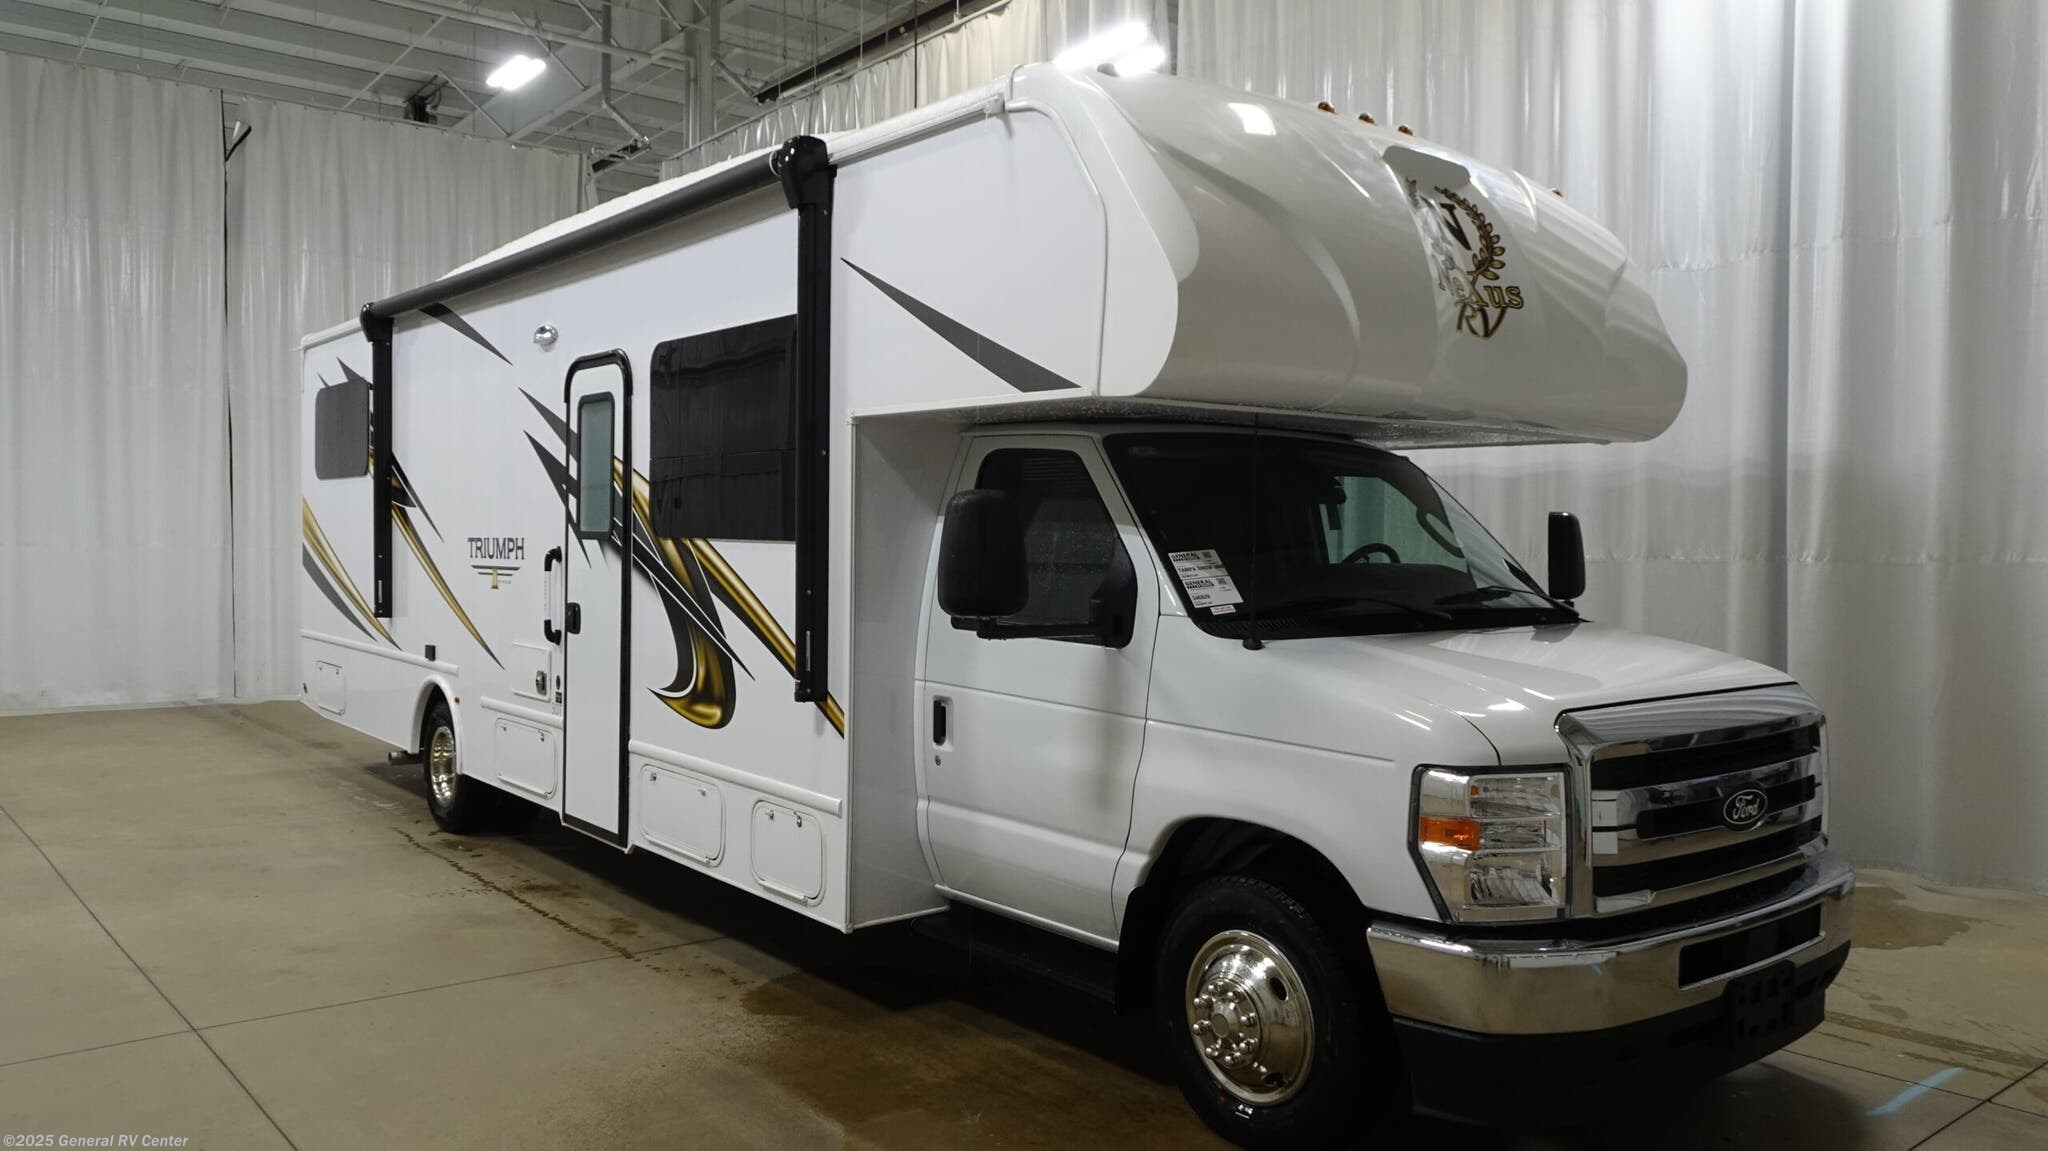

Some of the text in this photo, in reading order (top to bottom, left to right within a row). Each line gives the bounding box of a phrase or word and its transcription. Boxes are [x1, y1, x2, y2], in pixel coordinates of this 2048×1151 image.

[1455, 299, 1509, 339] RV
[467, 537, 525, 560] TRIUMPH
[1732, 795, 1760, 820] Ford
